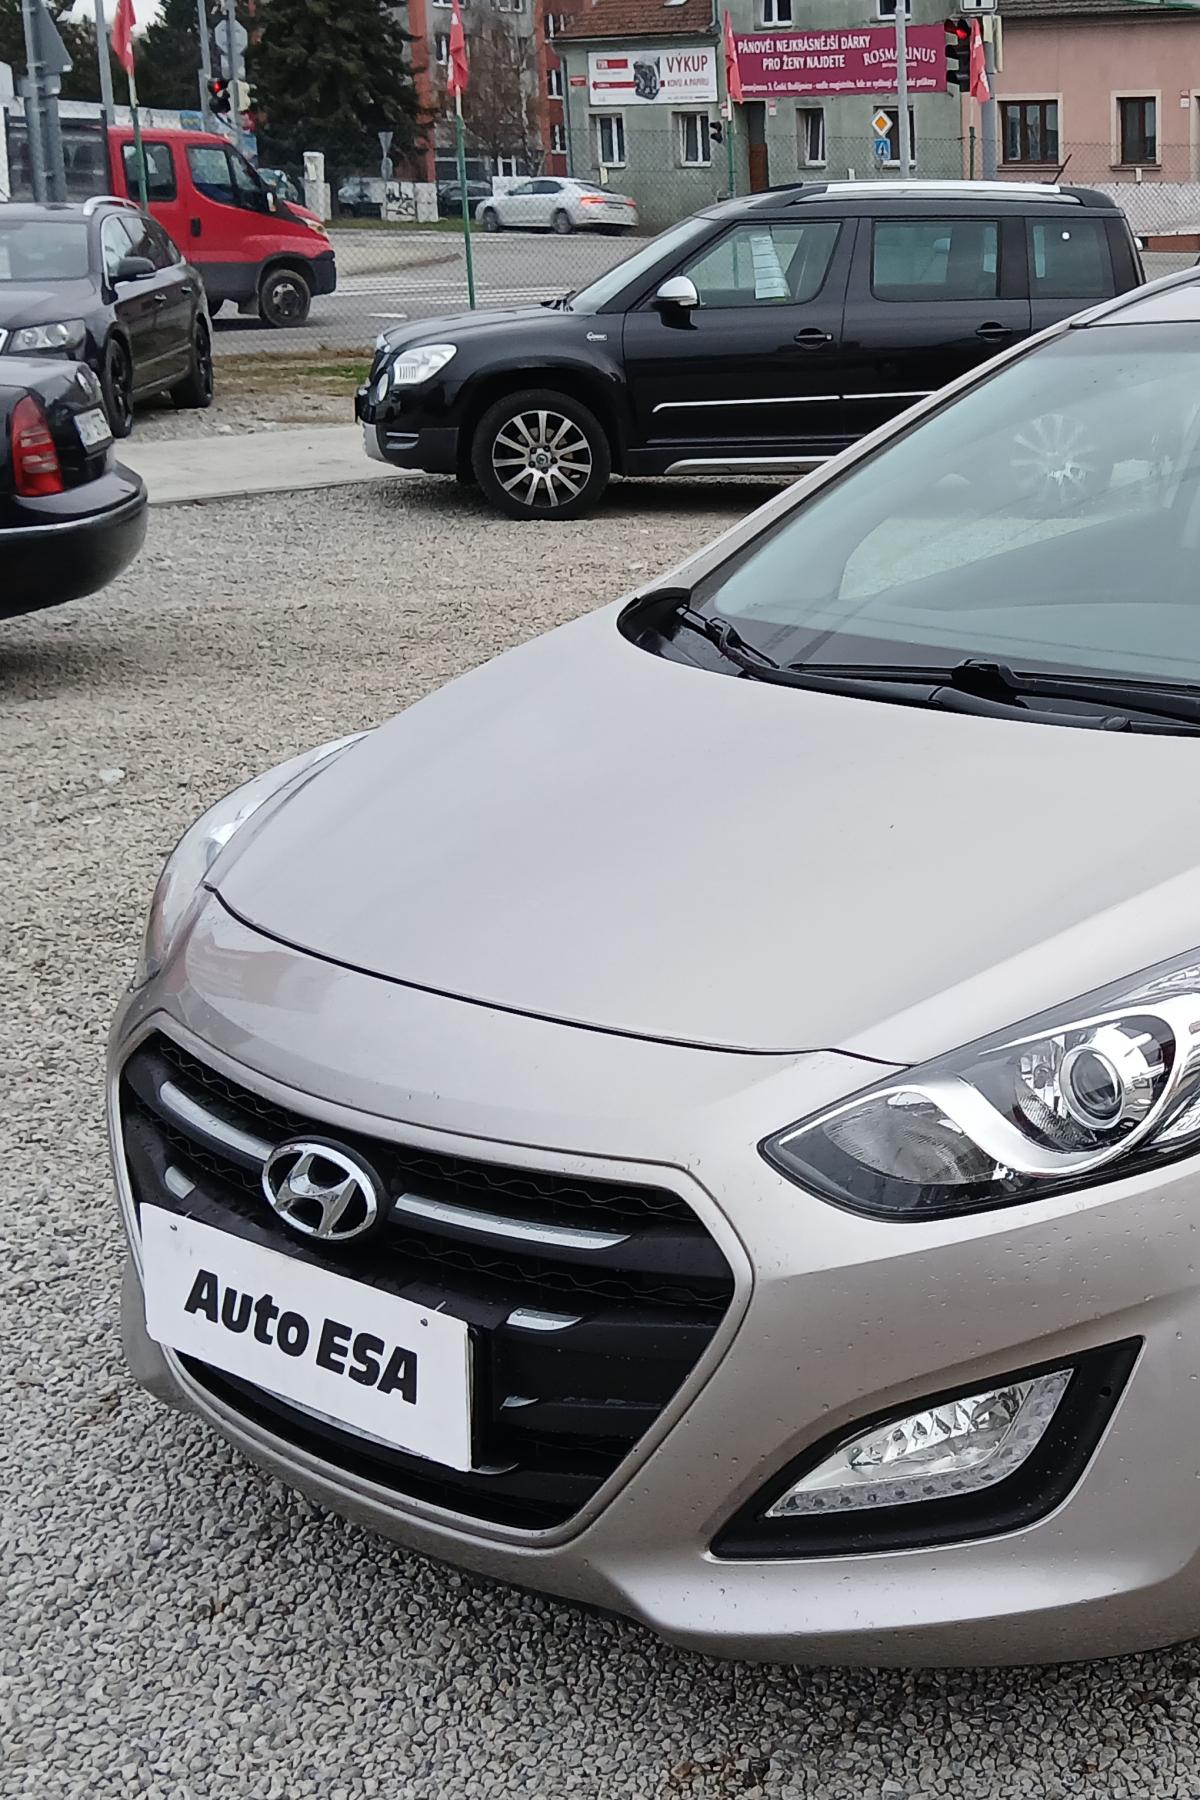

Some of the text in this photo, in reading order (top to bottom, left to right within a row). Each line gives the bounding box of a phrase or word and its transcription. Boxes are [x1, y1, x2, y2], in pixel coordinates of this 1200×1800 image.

[841, 34, 871, 49] DÁRKY
[666, 53, 708, 73] VÝKUP
[762, 54, 846, 71] PRO ŽENY NAJDETE
[863, 46, 937, 66] ROSMINUS
[184, 1269, 419, 1405] Auto ESA
